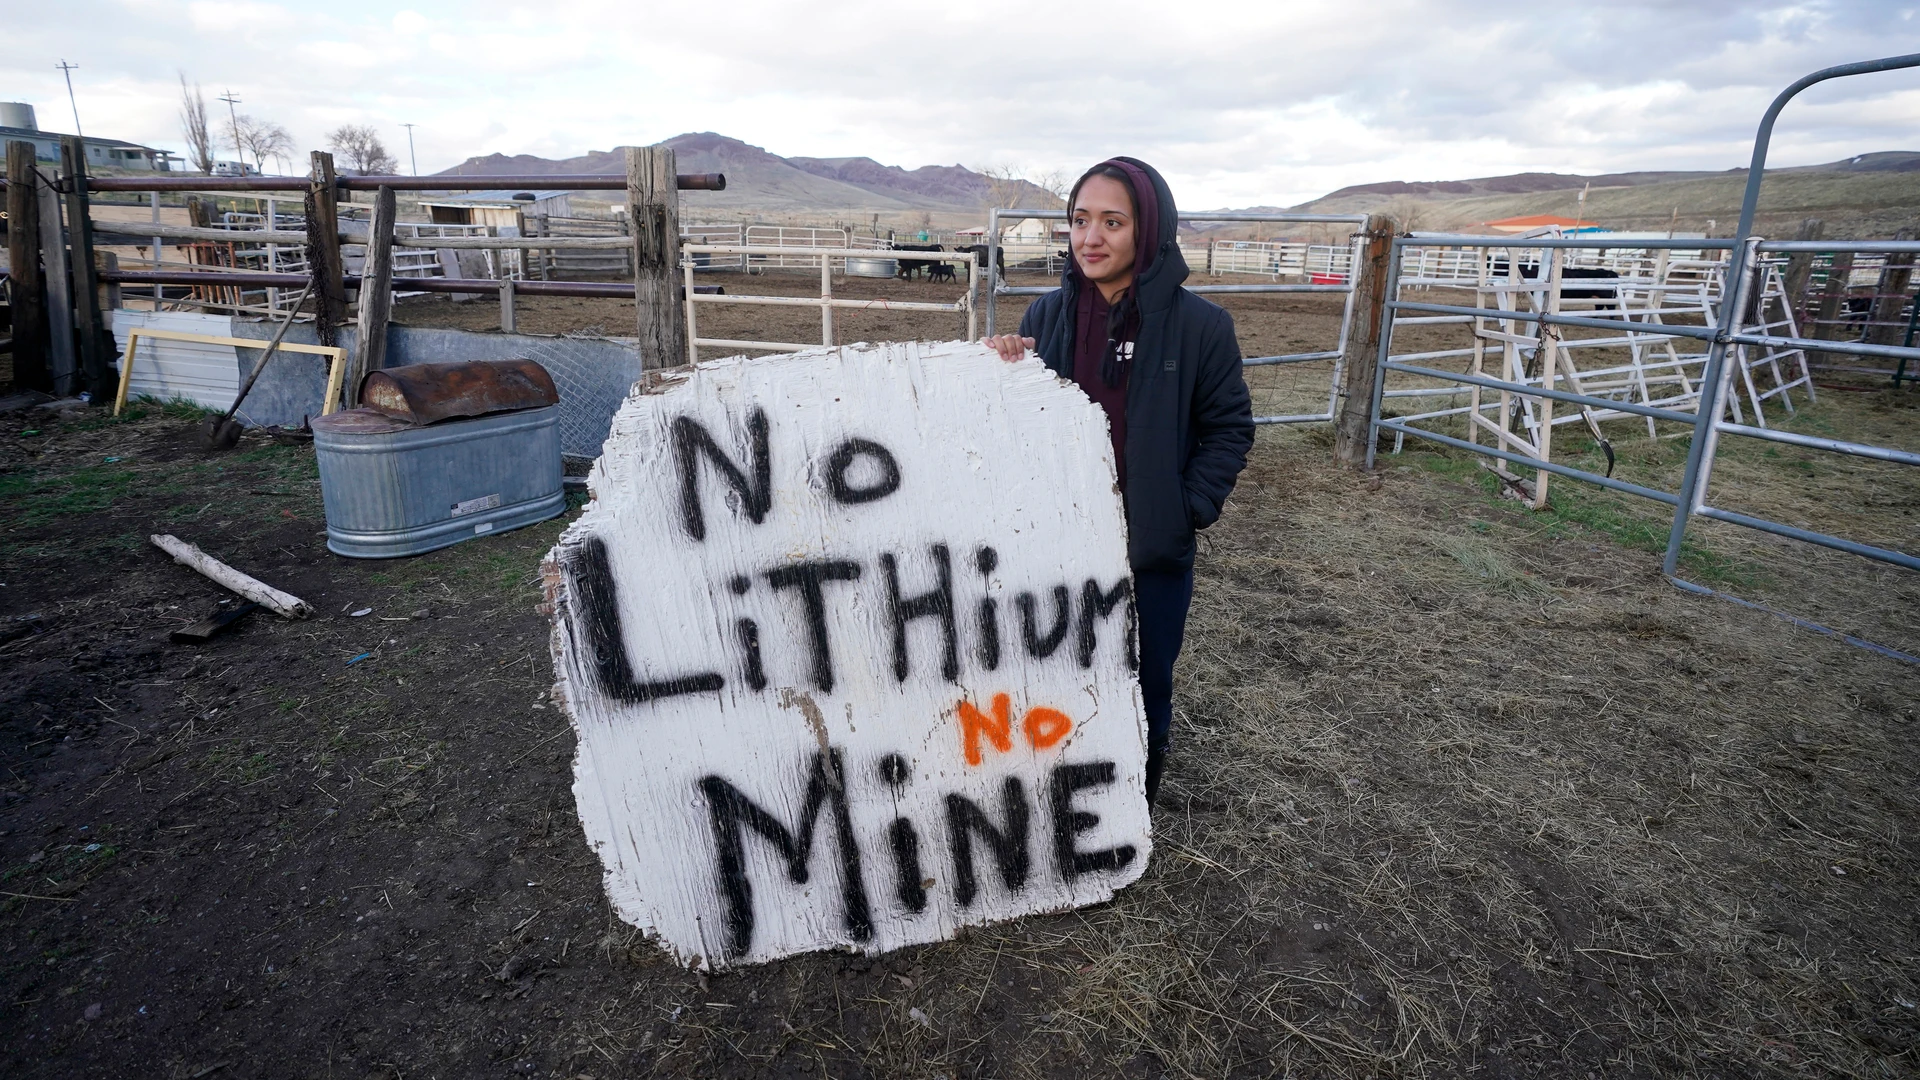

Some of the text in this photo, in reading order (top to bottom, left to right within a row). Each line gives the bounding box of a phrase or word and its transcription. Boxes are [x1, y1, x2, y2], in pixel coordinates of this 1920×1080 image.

[672, 408, 902, 541] No
[957, 692, 1073, 766] No
[700, 746, 1137, 956] MiNE
